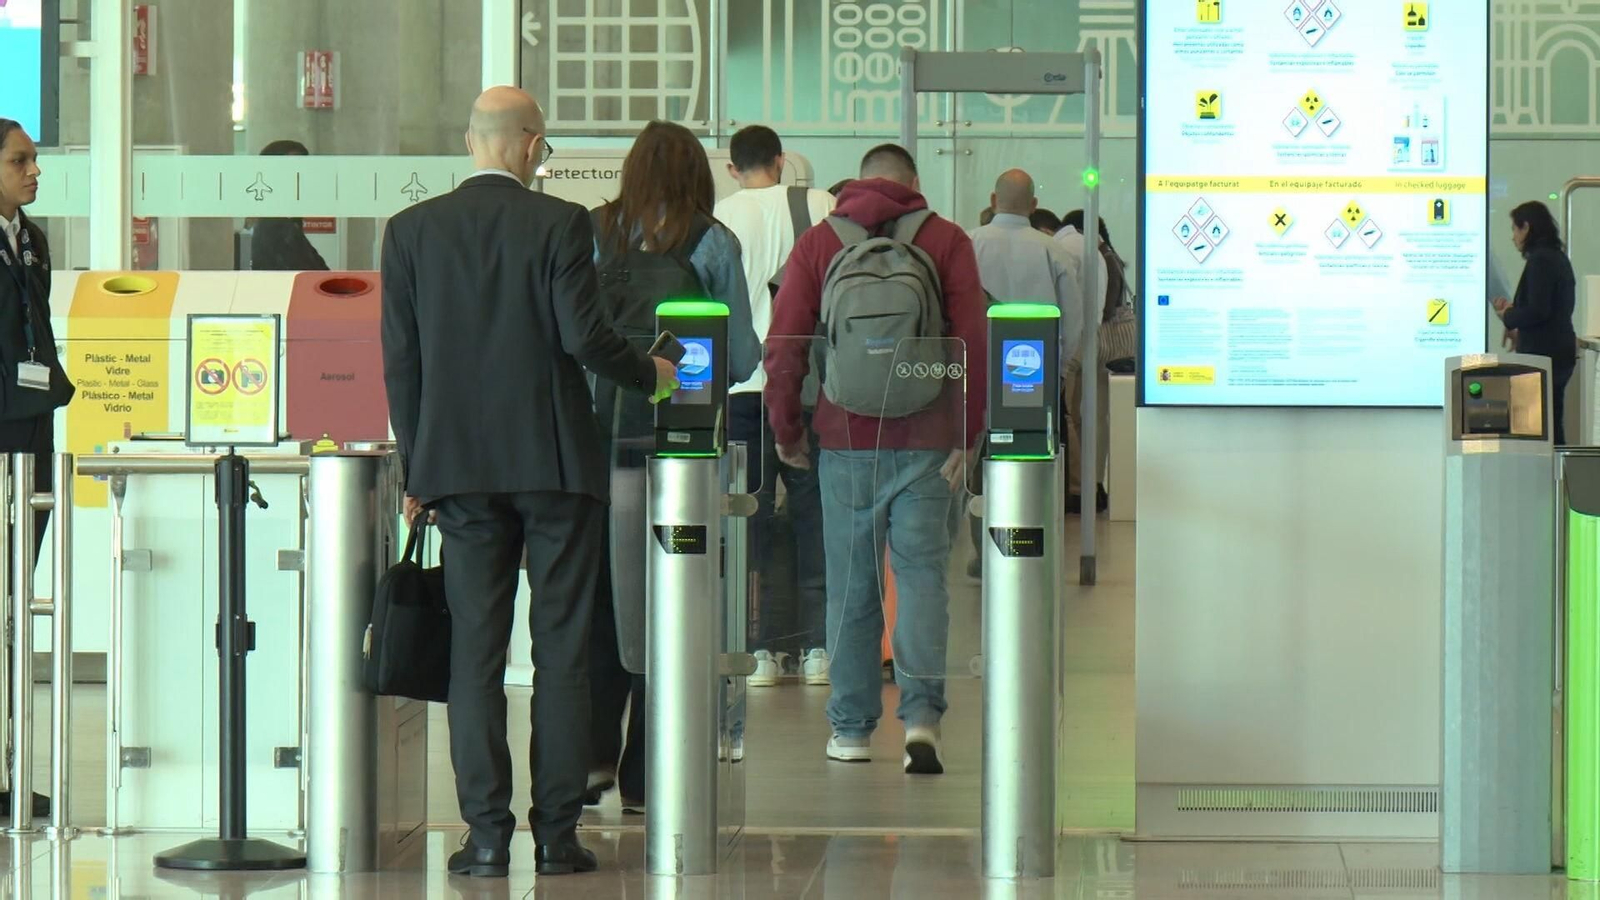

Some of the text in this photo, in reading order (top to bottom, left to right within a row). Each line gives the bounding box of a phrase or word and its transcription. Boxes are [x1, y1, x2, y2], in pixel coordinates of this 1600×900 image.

[1289, 180, 1323, 189] equipaje
[1325, 180, 1362, 188] facturado
[1435, 181, 1466, 190] luggage
[125, 353, 151, 363] Metal
[105, 366, 130, 375] Vidre
[320, 372, 355, 381] Aerosol
[77, 379, 101, 388] Plastic
[108, 379, 130, 388] Metal
[136, 379, 159, 388] Glass
[128, 391, 154, 400] Metal
[104, 403, 132, 413] Vidrio
